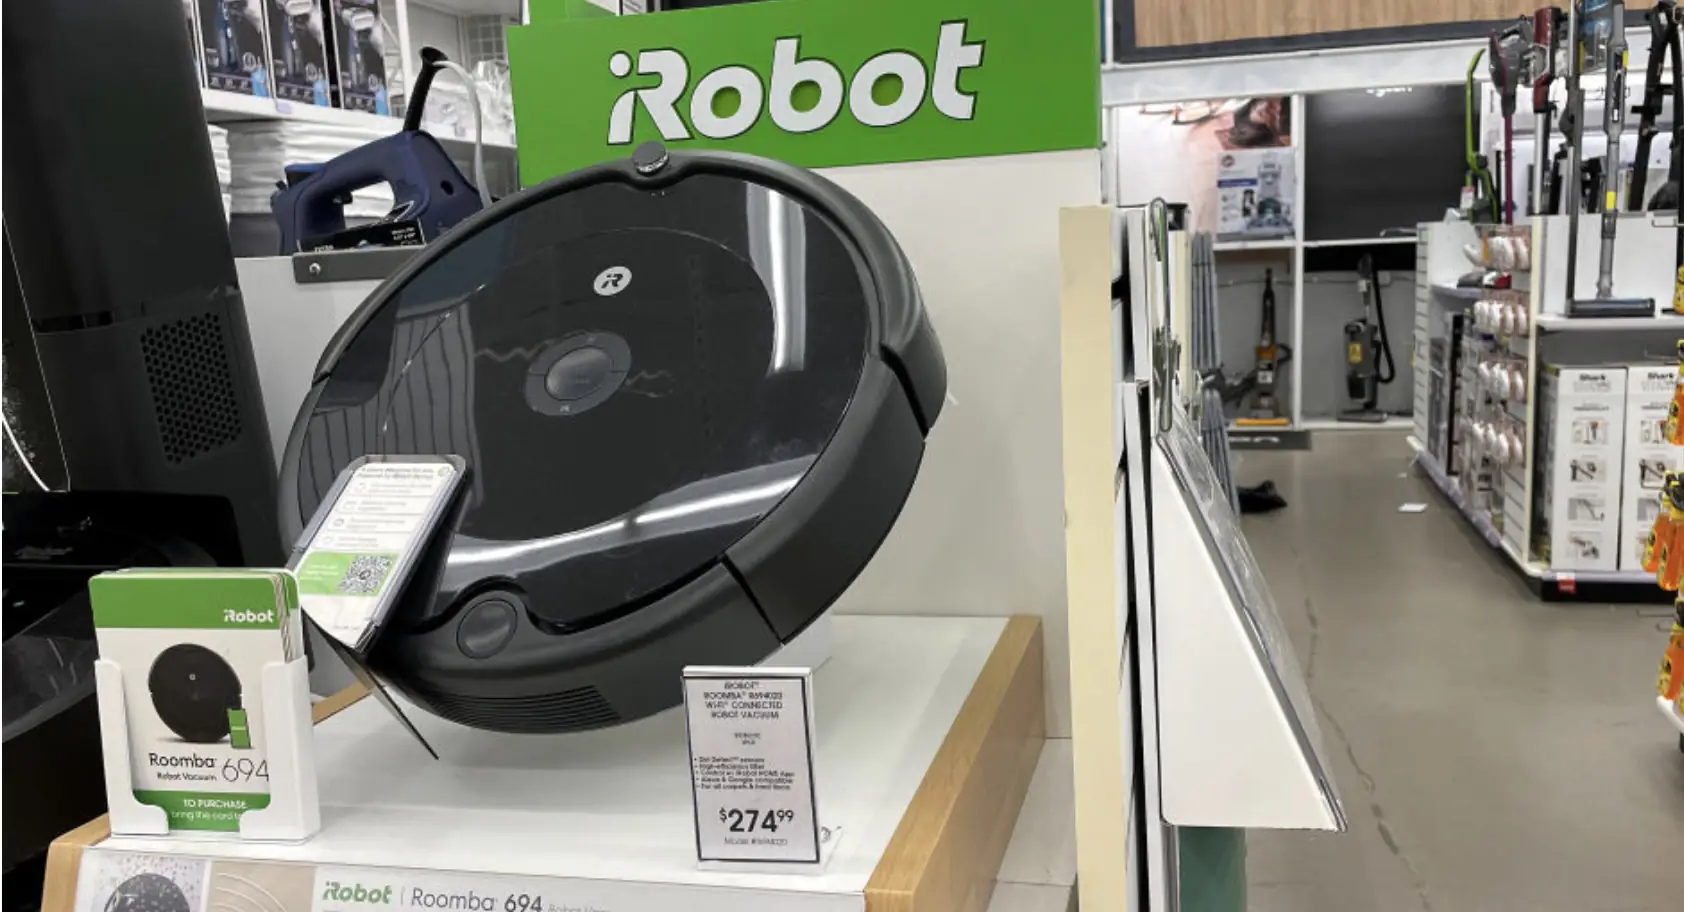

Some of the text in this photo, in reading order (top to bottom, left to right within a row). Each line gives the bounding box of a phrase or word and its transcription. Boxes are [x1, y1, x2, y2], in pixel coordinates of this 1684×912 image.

[607, 18, 986, 145] iRobot
[223, 608, 274, 623] iRobot
[222, 757, 270, 782] 694
[183, 798, 248, 810] TO PURCHASE
[322, 880, 393, 904] iRobot
[504, 893, 543, 912] 694
